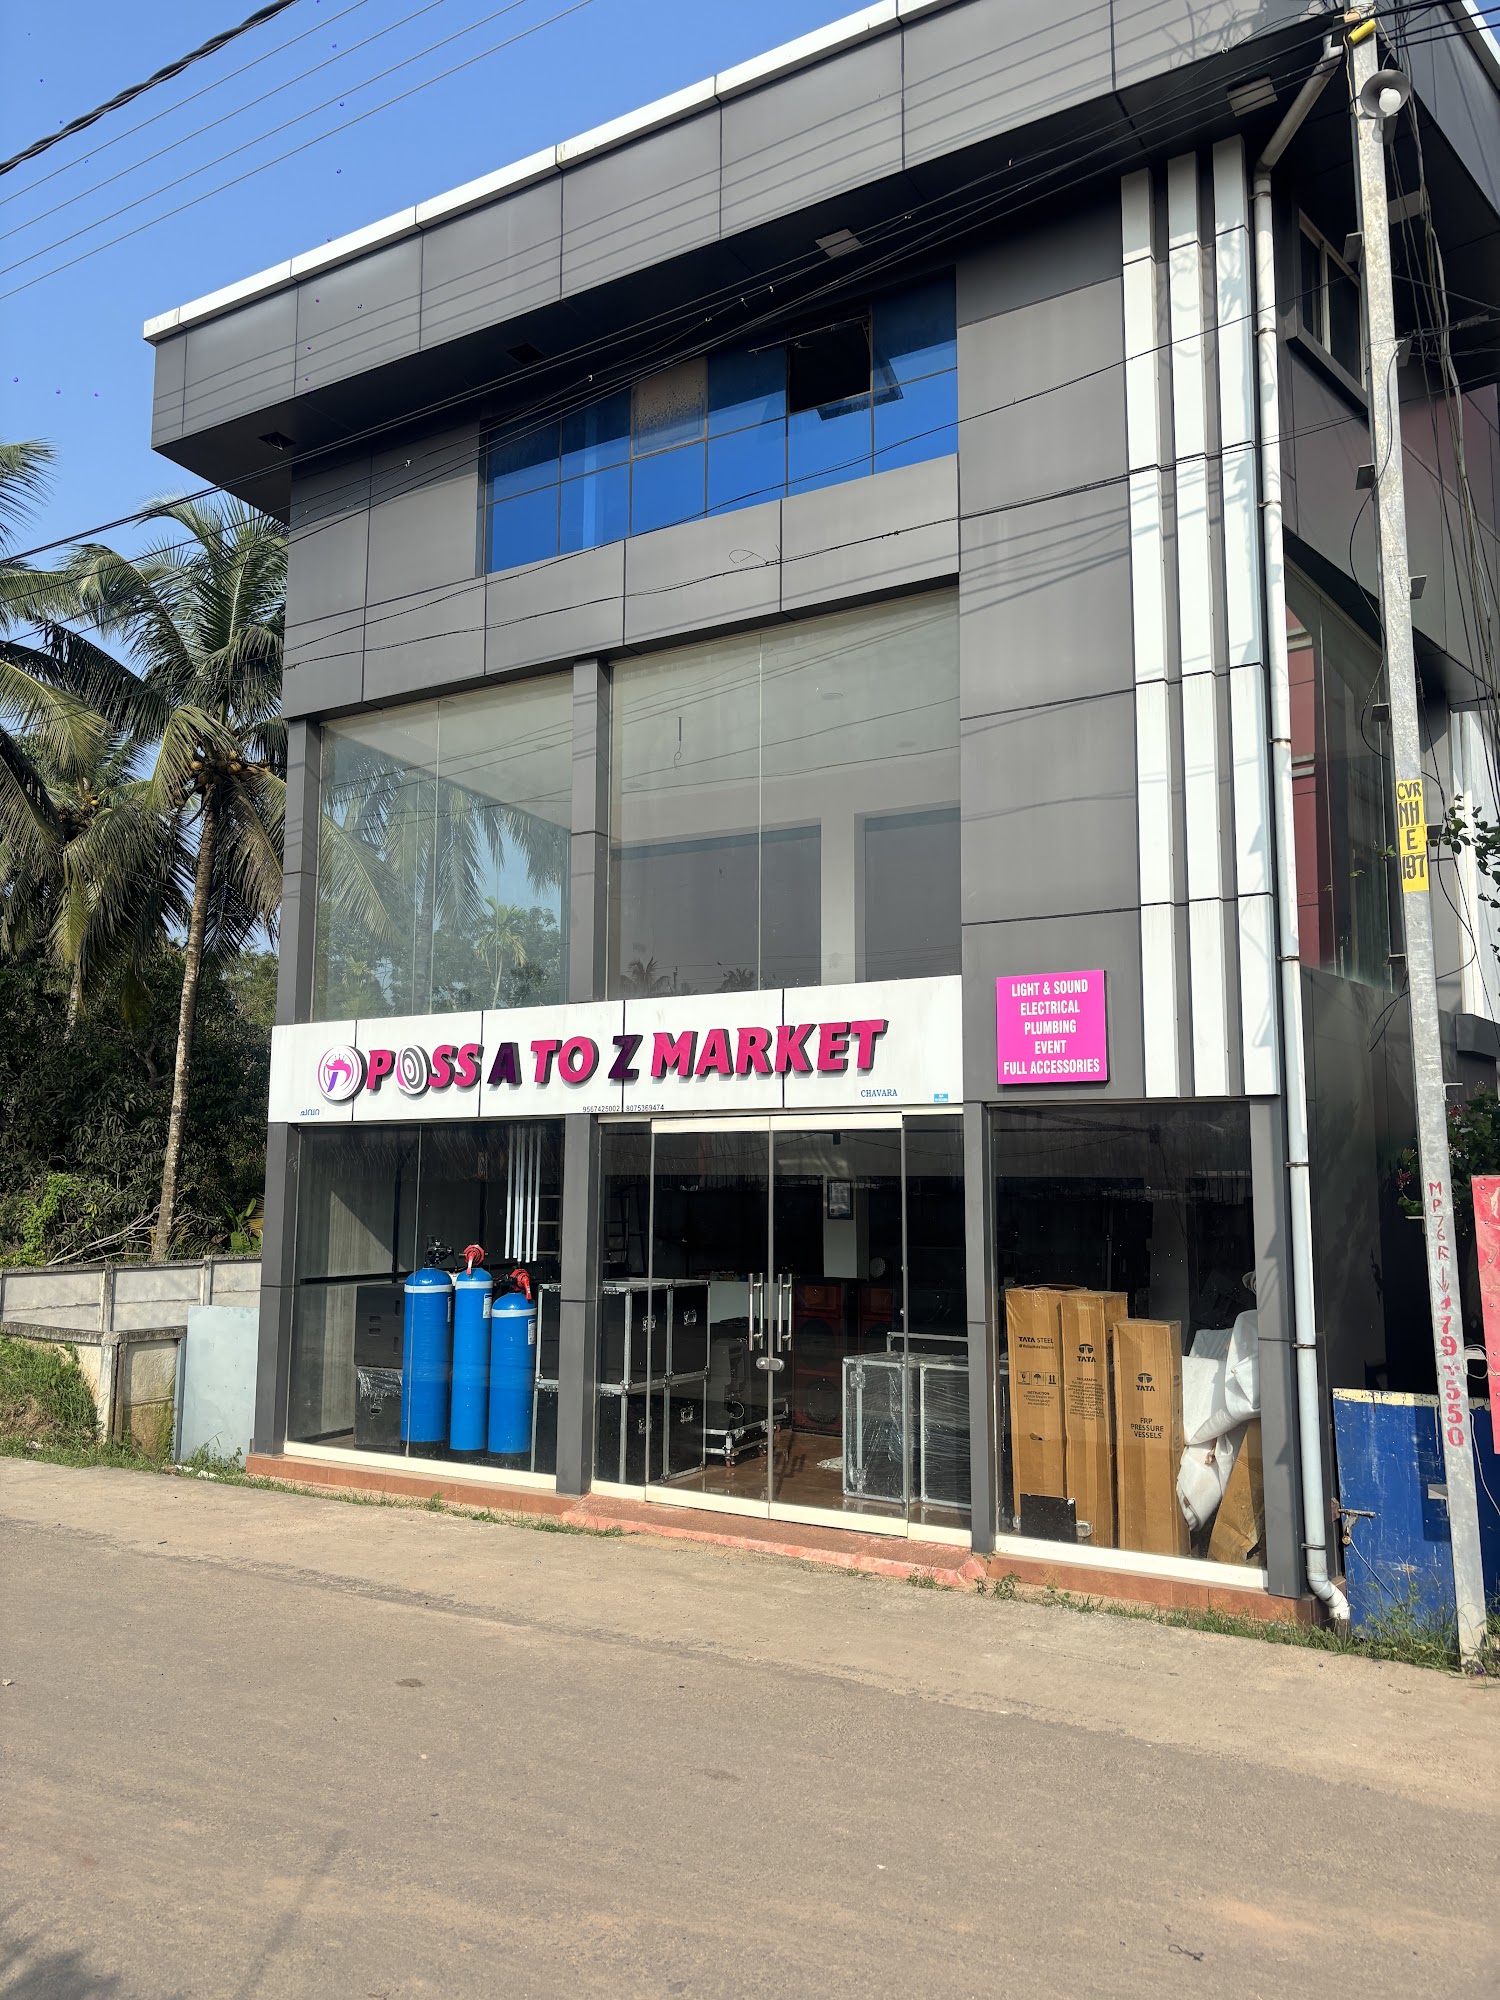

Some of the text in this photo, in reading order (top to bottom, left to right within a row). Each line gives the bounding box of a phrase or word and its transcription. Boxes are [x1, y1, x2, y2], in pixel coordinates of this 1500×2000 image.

[1397, 782, 1421, 800] CVR
[1398, 801, 1420, 827] NH
[1406, 829, 1418, 850] E
[1402, 854, 1426, 879] 197
[1012, 979, 1088, 997] LIGHT & SOUND
[1020, 1000, 1080, 1016] ELECTRICAL
[1024, 1019, 1077, 1035] PLUMBING
[1035, 1040, 1067, 1054] EVENT
[366, 1019, 889, 1095] POSS A TO Z MARKET
[1003, 1058, 1100, 1075] FULL ACCESSORIES
[860, 1089, 898, 1098] CHAVARA
[1130, 1424, 1164, 1432] PRESSURE
[1134, 1431, 1162, 1439] VESSELS
